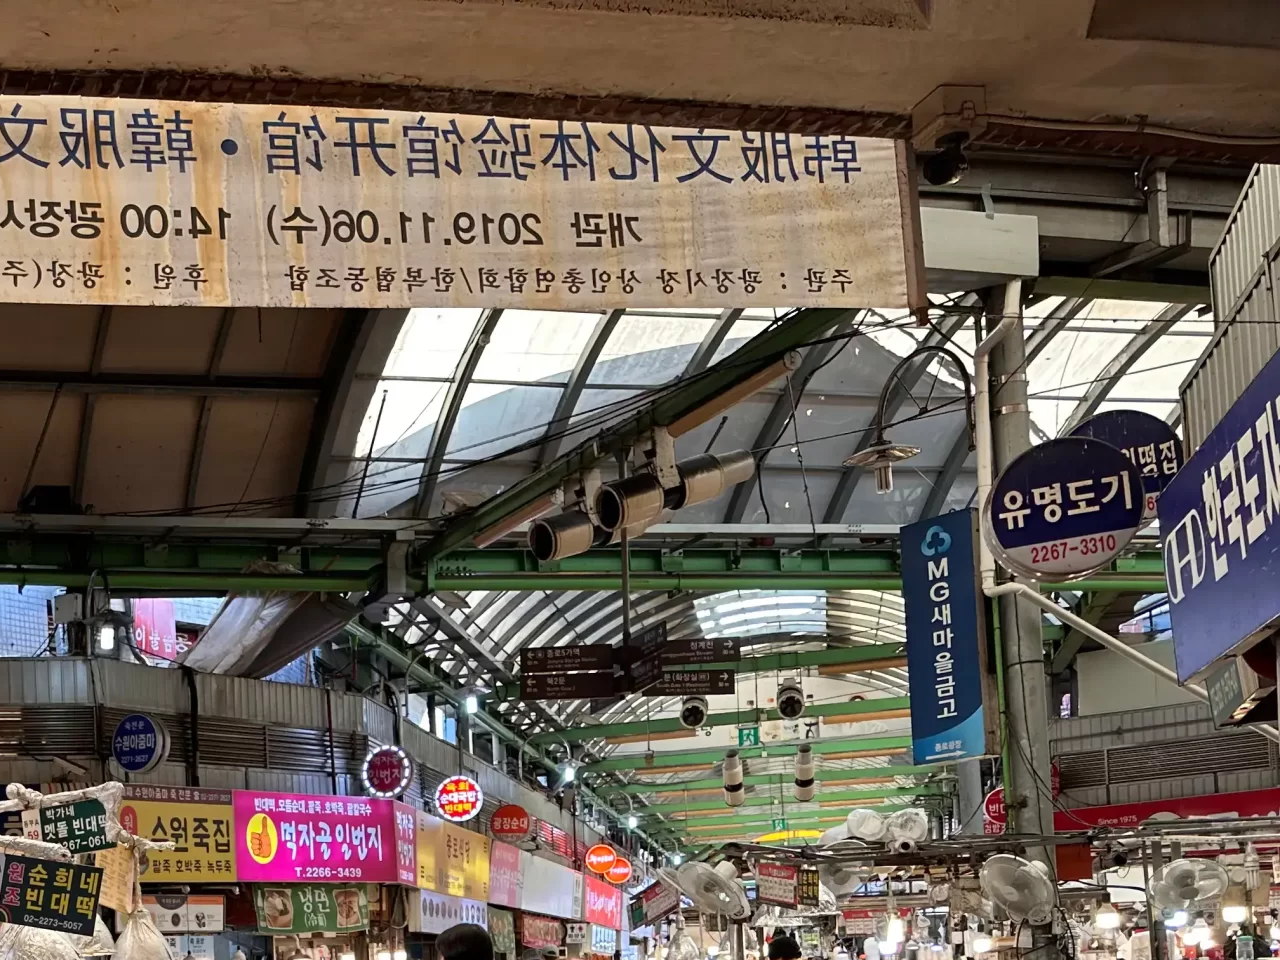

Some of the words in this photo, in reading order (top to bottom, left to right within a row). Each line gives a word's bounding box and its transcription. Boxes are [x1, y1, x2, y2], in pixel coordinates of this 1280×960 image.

[998, 470, 1132, 531] 유명도기
[1030, 534, 1116, 565] 2267-3310
[927, 557, 958, 719] MG새마을금고
[124, 721, 145, 731] 죽전문
[115, 733, 155, 752] 수원아줌마
[135, 787, 168, 799] 수원아줌마
[440, 791, 477, 805] 순대국밥
[45, 805, 75, 820] 박가네
[444, 802, 472, 813] 빈대떡
[493, 816, 529, 830] 광장순대
[1097, 817, 1119, 826] Since
[1119, 815, 1138, 824] 1975
[27, 829, 39, 840] 59
[44, 820, 69, 840] 멧돌
[151, 816, 231, 853] 수원죽집
[28, 864, 99, 895] 순희네
[294, 867, 362, 878] T.2266-3439
[25, 888, 95, 920] 빈대떡
[298, 886, 330, 912] 냉면
[23, 913, 83, 931] 02-2273-5057
